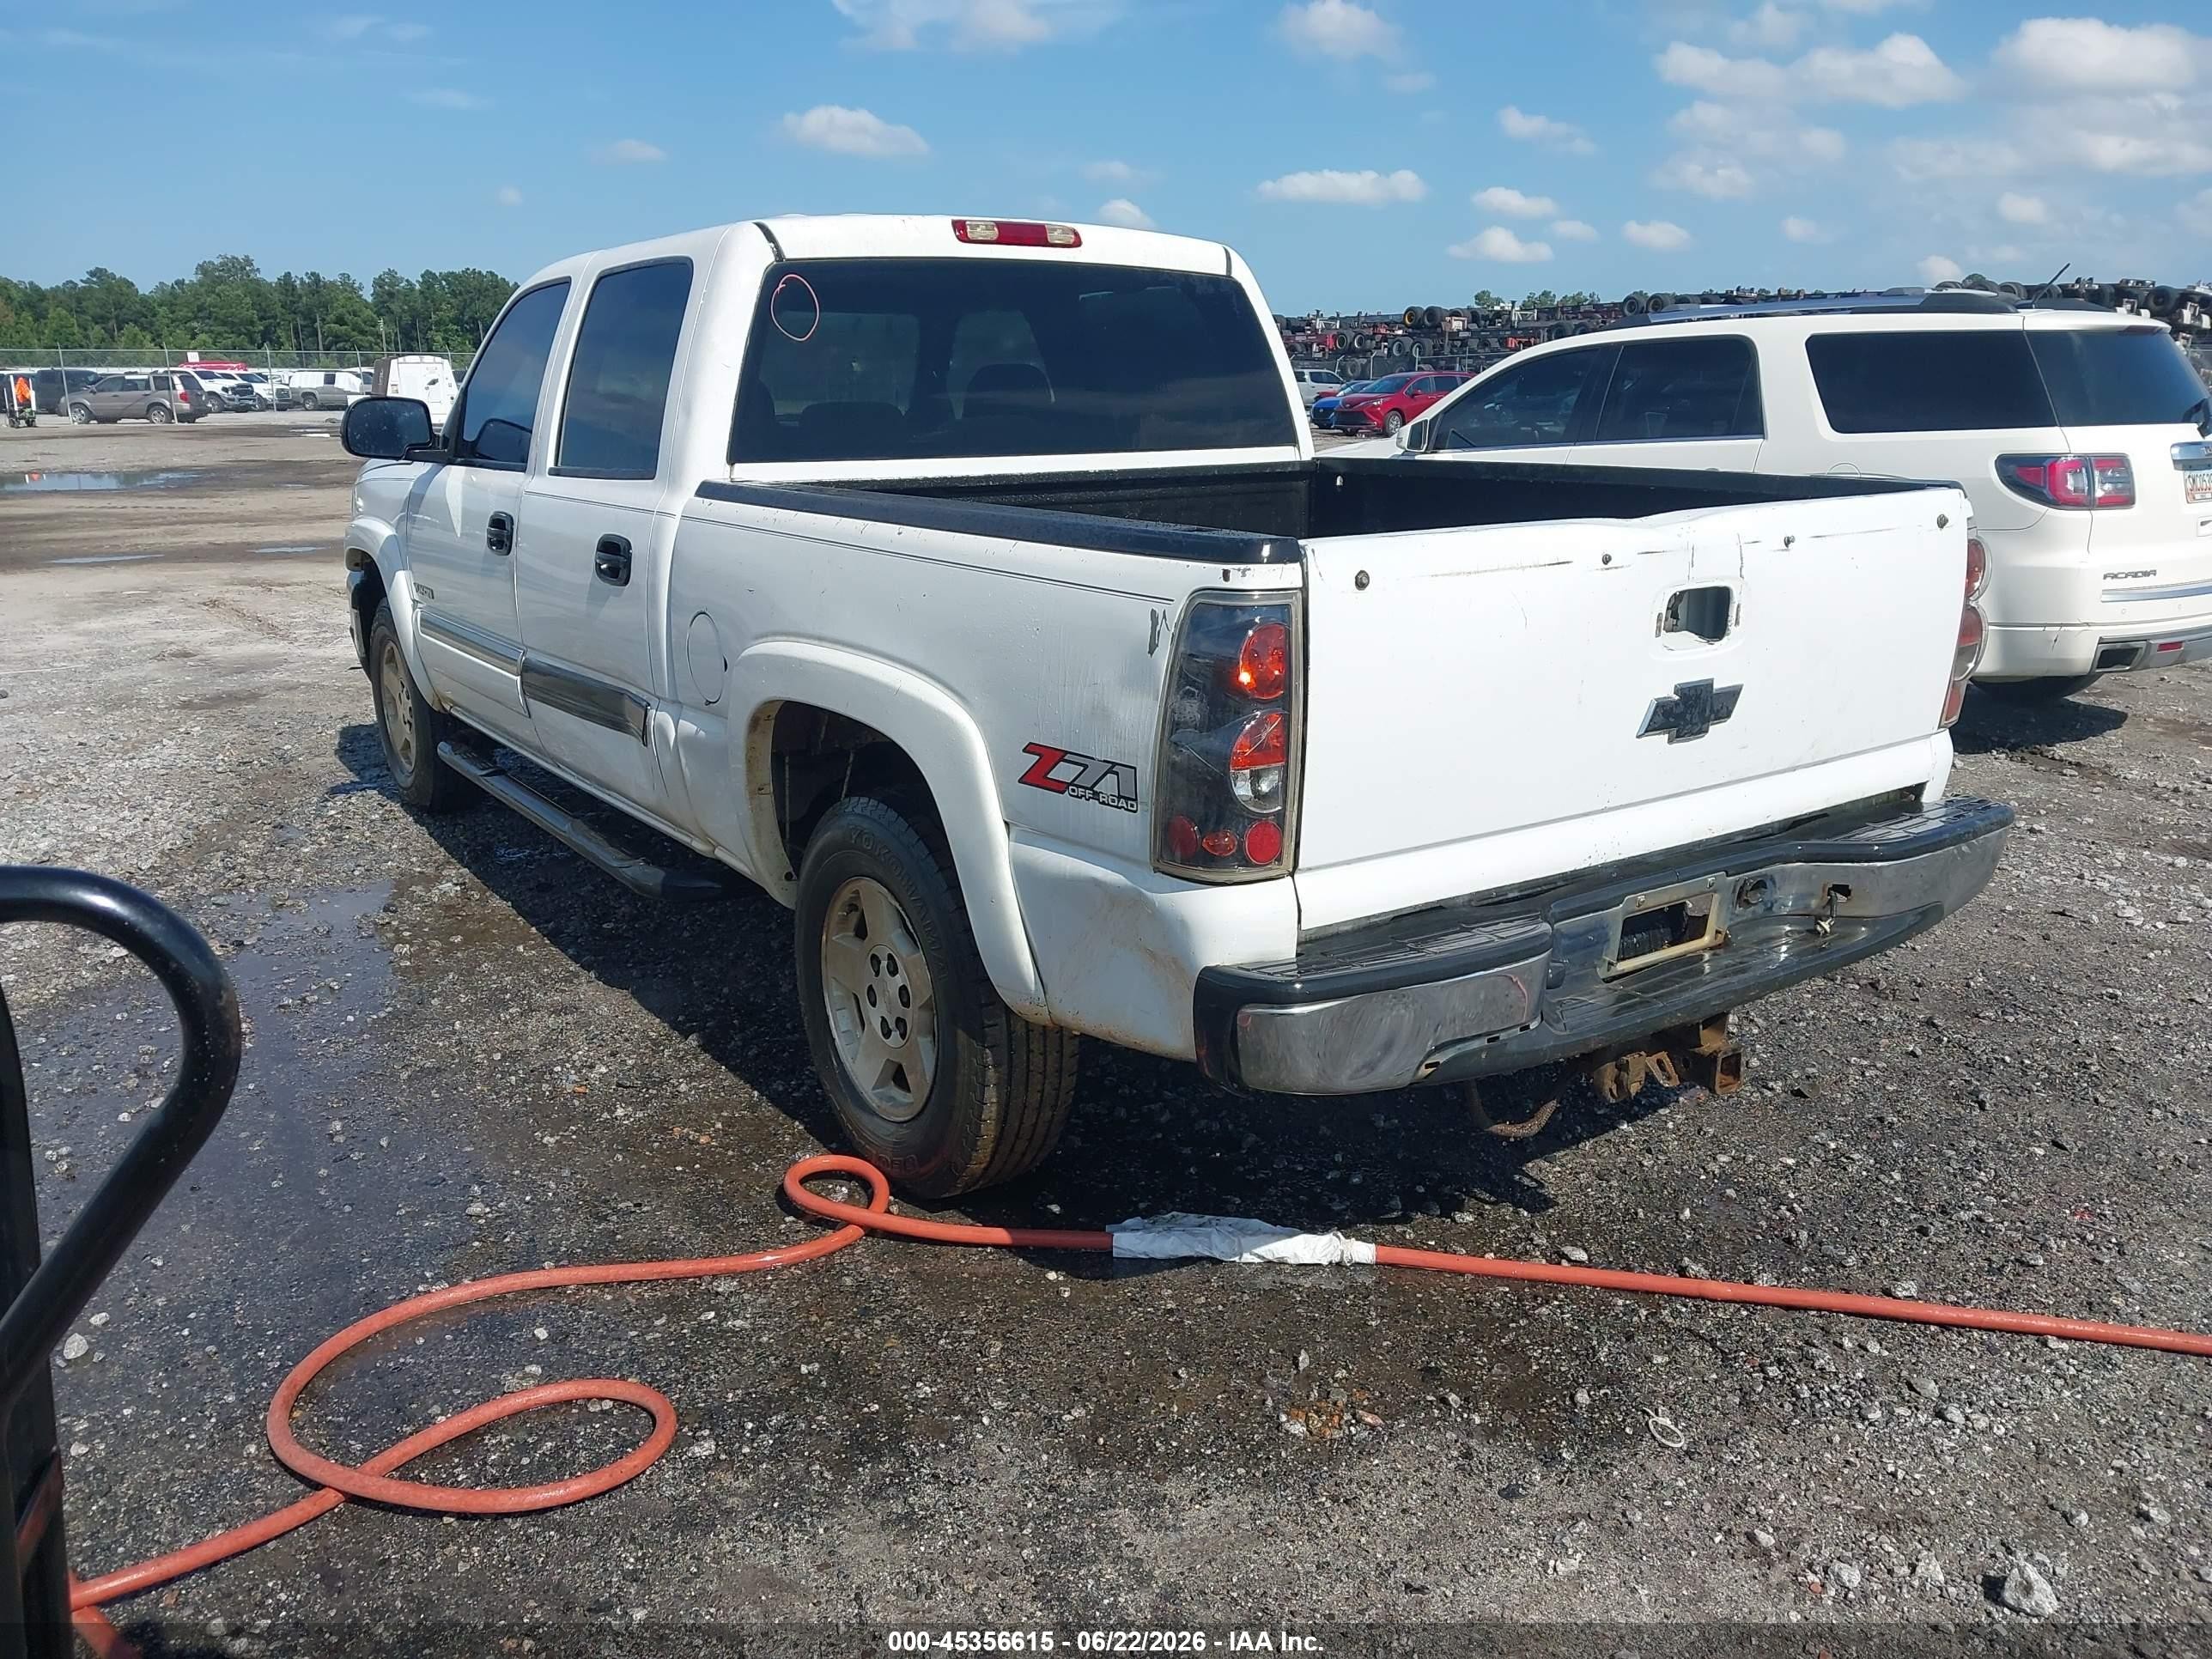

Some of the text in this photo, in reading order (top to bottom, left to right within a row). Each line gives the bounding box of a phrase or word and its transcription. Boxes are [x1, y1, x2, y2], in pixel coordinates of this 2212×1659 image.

[2103, 569, 2157, 580] ACADIA
[1018, 742, 1138, 800] Z71
[1068, 786, 1138, 812] OFF ROAD
